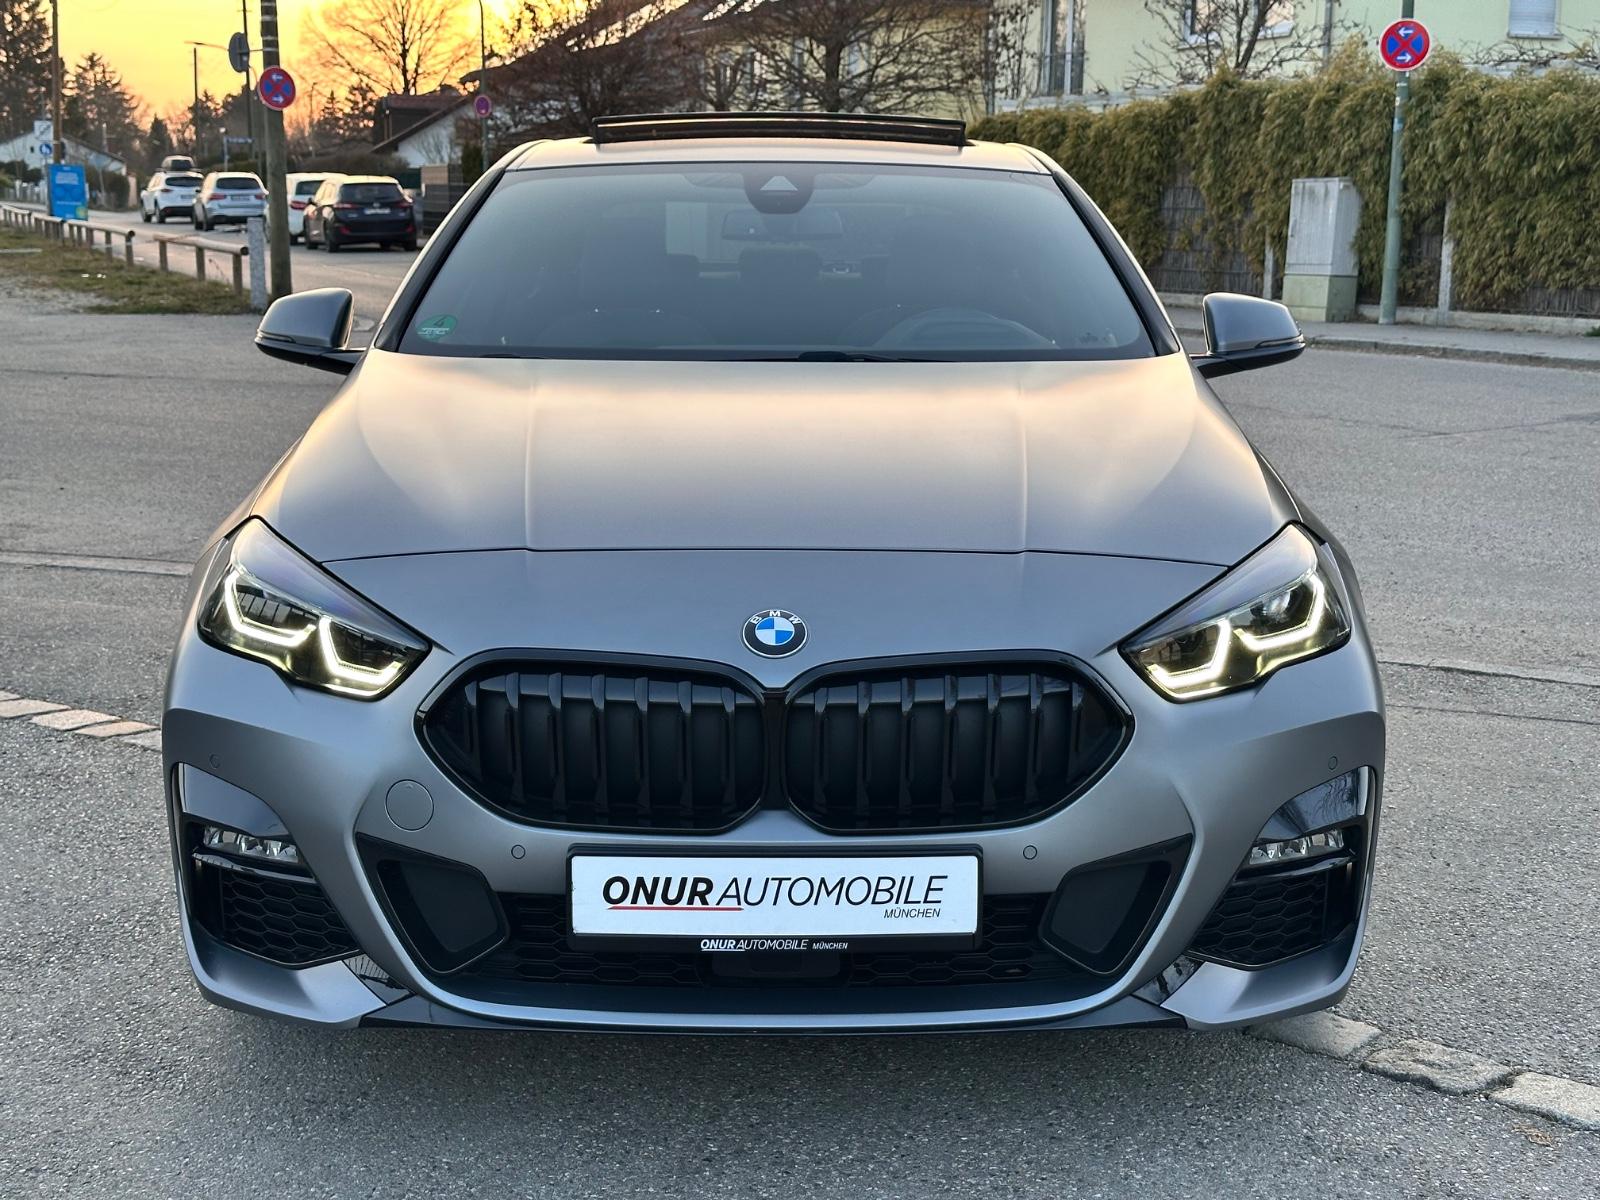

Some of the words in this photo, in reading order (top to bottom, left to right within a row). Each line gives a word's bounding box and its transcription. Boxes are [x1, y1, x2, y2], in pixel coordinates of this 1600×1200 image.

[750, 610, 802, 625] BMW
[884, 907, 941, 919] MÜNCHEN
[812, 942, 849, 950] MÜNCHEN
